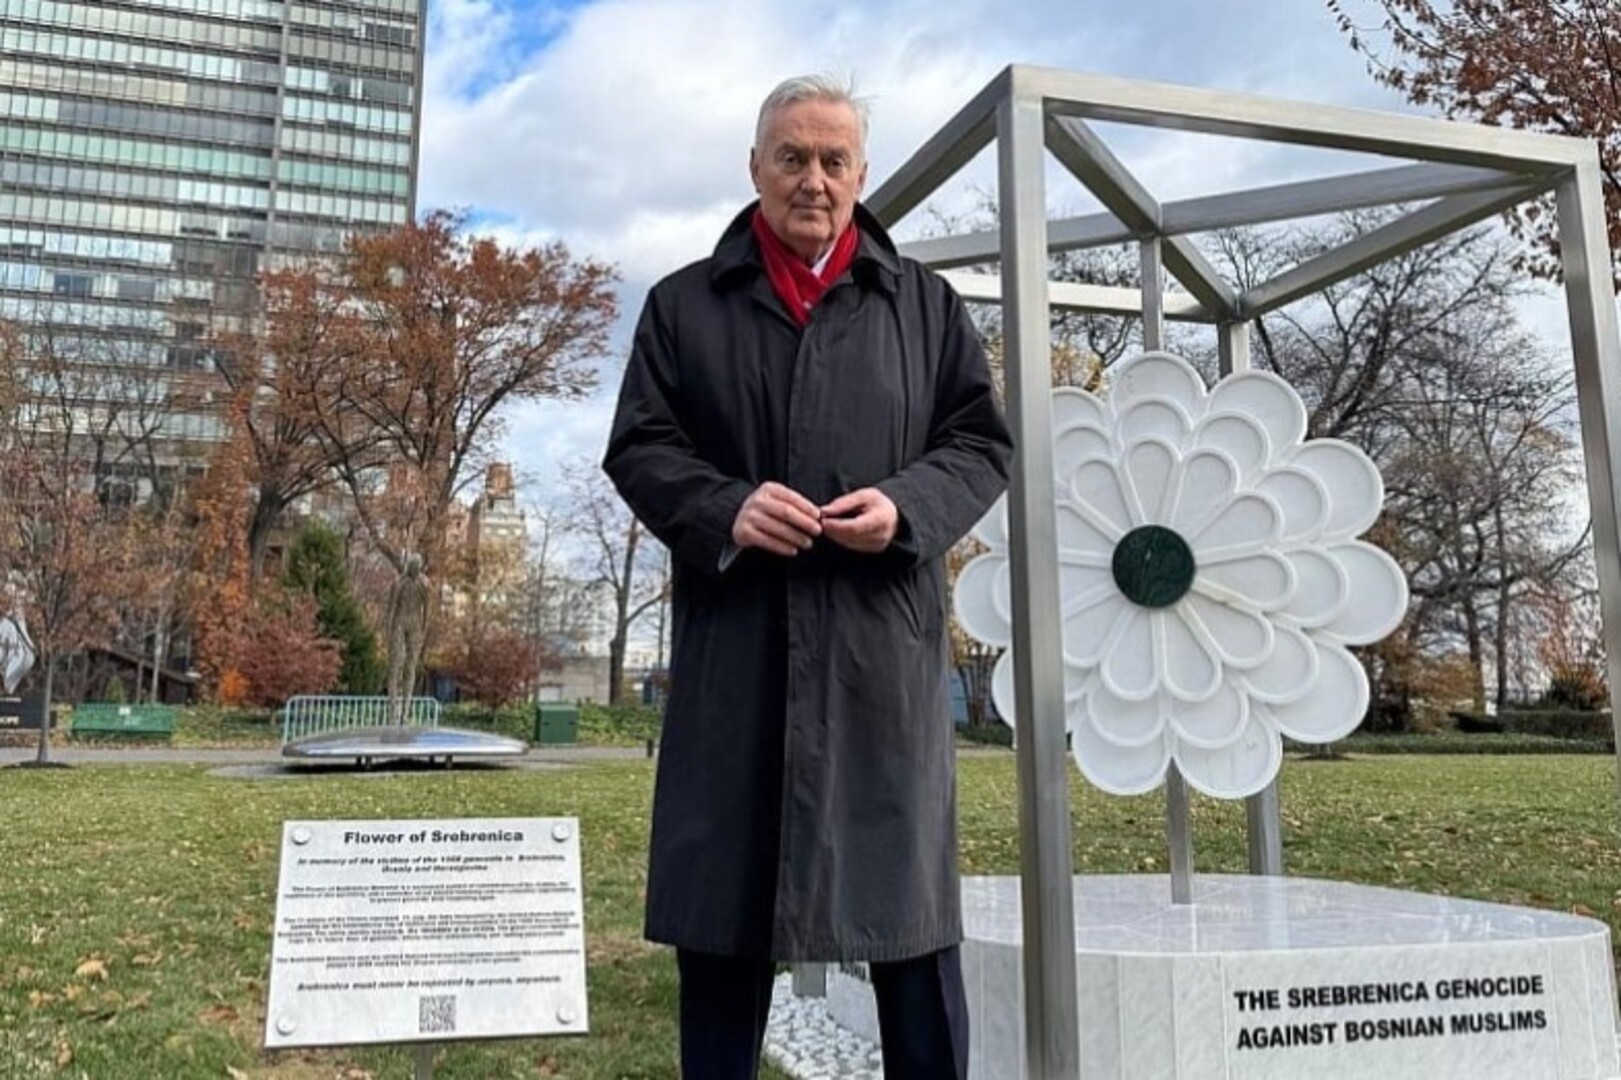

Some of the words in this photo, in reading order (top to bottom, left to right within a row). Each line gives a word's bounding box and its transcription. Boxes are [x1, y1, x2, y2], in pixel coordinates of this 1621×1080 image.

[344, 830, 404, 844] Flower
[409, 830, 427, 843] of
[431, 829, 524, 843] Srebrenica
[1233, 989, 1281, 1012] THE
[1286, 981, 1430, 1009] SREBRENICA
[1435, 974, 1544, 1001] GENOCIDE
[1236, 1022, 1338, 1050] AGAINST
[1344, 1015, 1444, 1042] BOSNIAN
[1450, 1009, 1547, 1034] MUSLIMS
